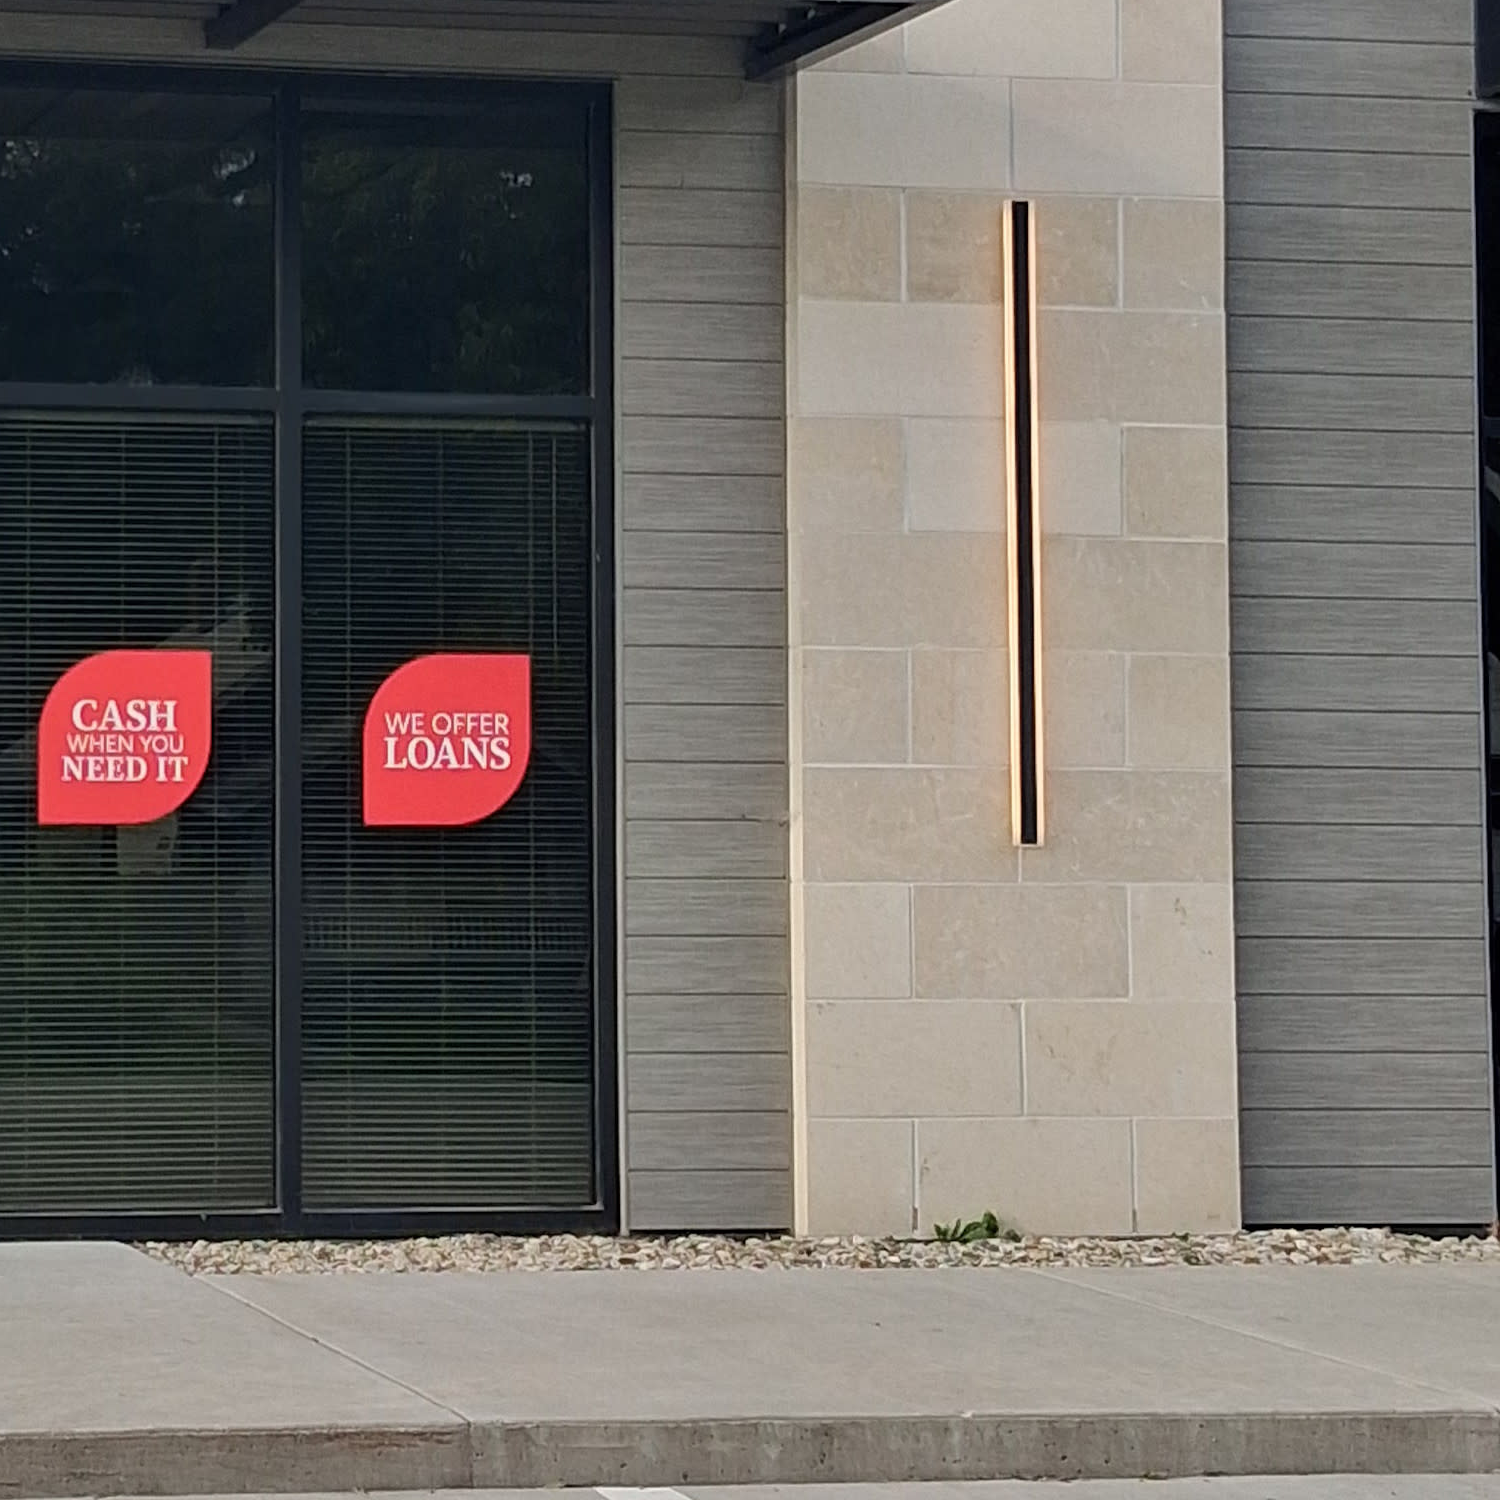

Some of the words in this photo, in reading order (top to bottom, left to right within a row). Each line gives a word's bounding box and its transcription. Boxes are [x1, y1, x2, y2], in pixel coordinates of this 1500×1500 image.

[71, 699, 178, 732] CASH
[384, 712, 425, 736] WE
[431, 712, 510, 737] OFFER
[66, 732, 134, 754] WHEN
[139, 734, 185, 754] YOU
[383, 736, 512, 771] LOANS
[60, 755, 148, 783] NEED
[155, 756, 189, 783] IT
